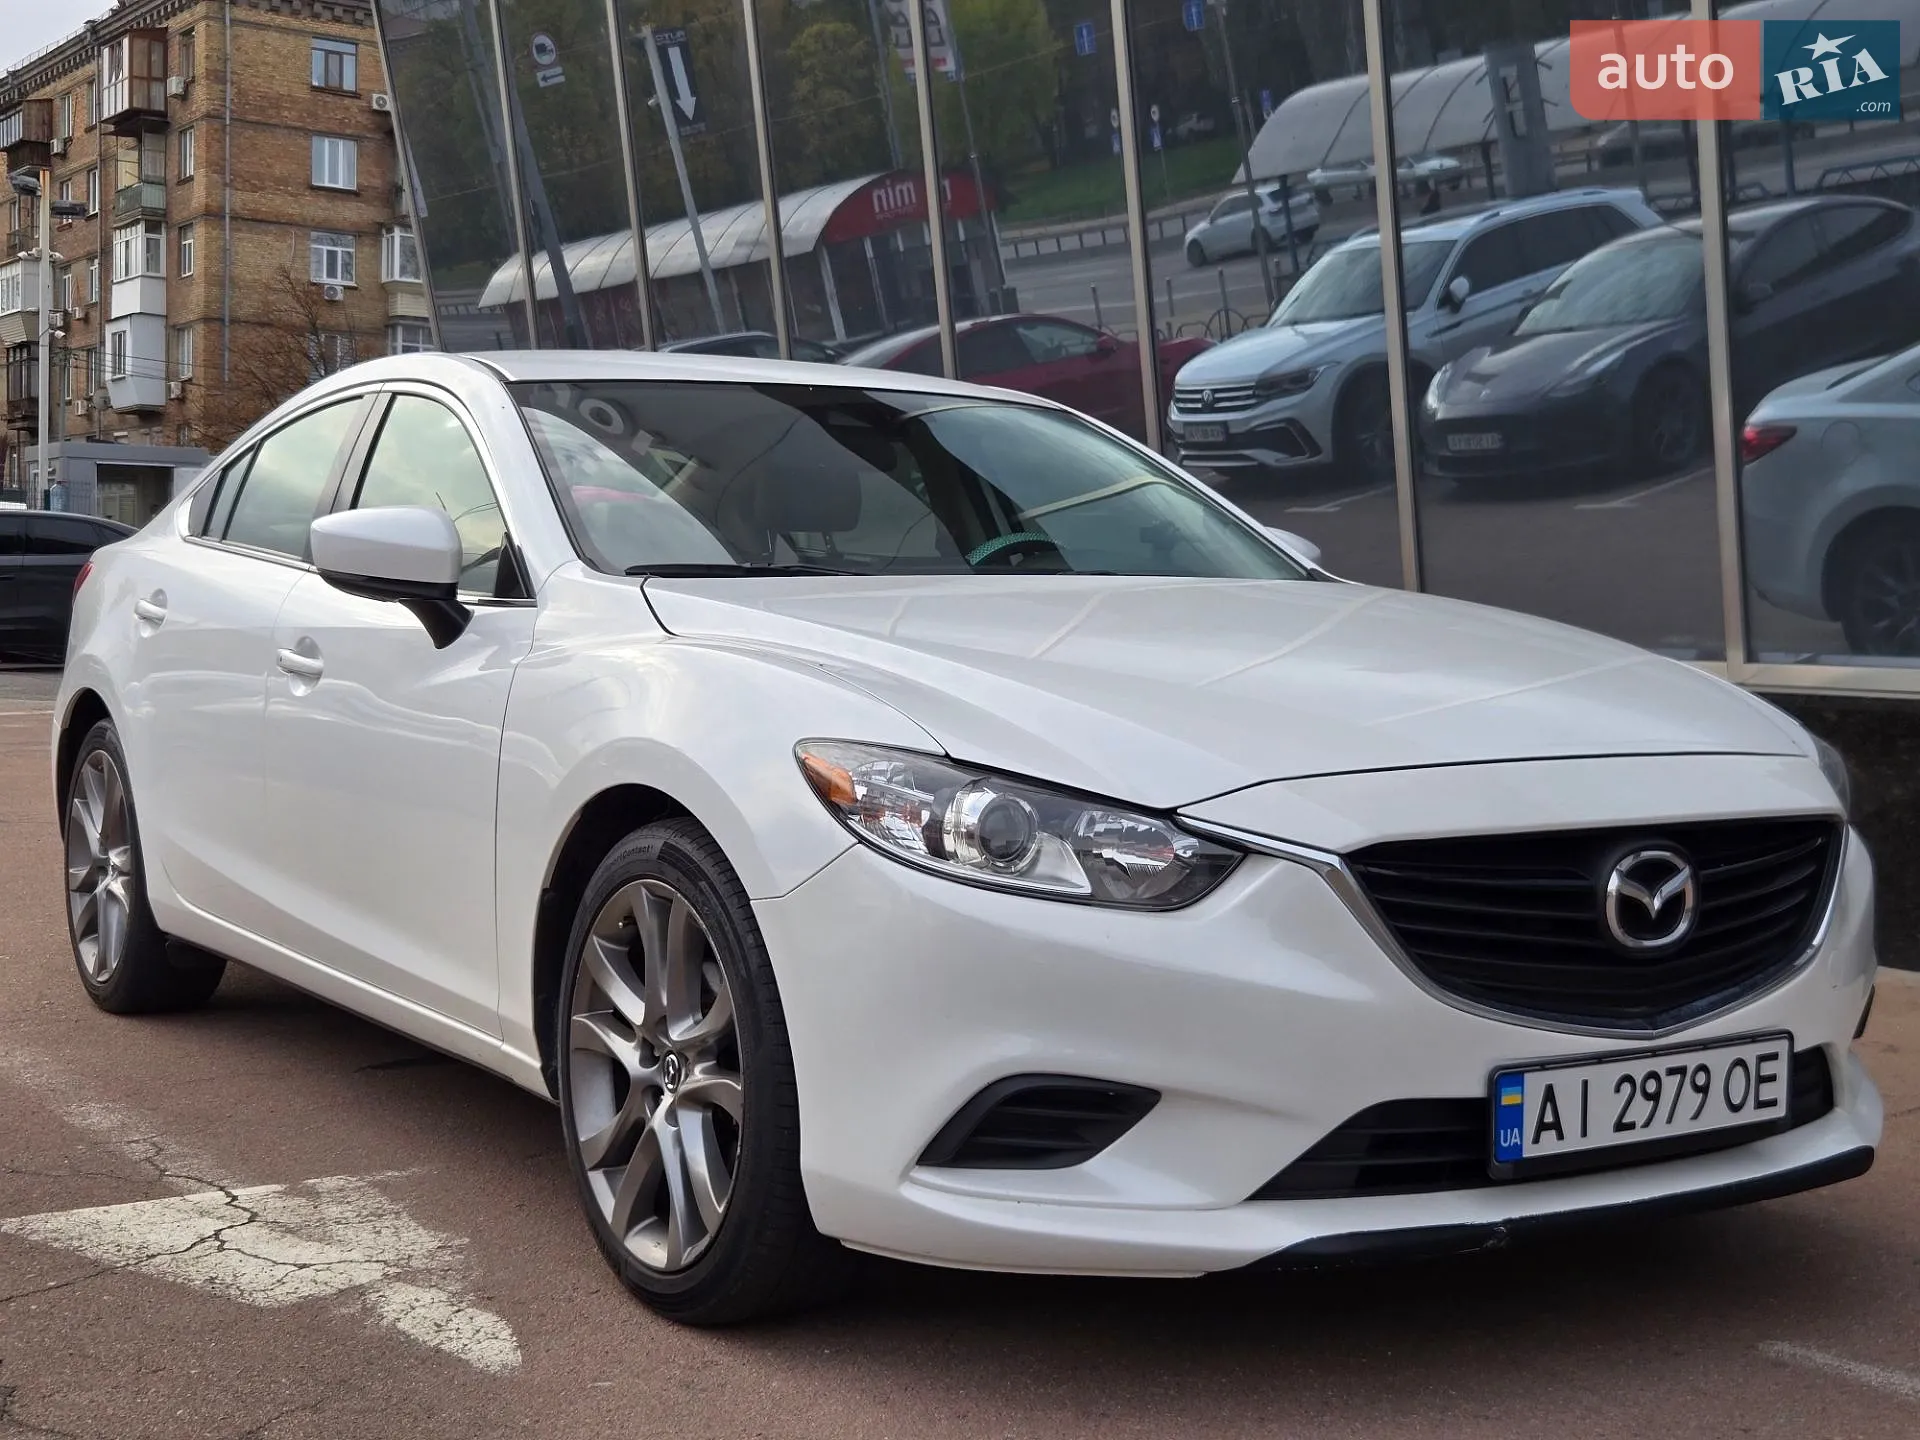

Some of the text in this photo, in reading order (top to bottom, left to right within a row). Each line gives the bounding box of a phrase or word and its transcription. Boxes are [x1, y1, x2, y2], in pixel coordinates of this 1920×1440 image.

[1531, 1051, 1779, 1144] AI 2979 OE
[1500, 1128, 1521, 1148] UA
